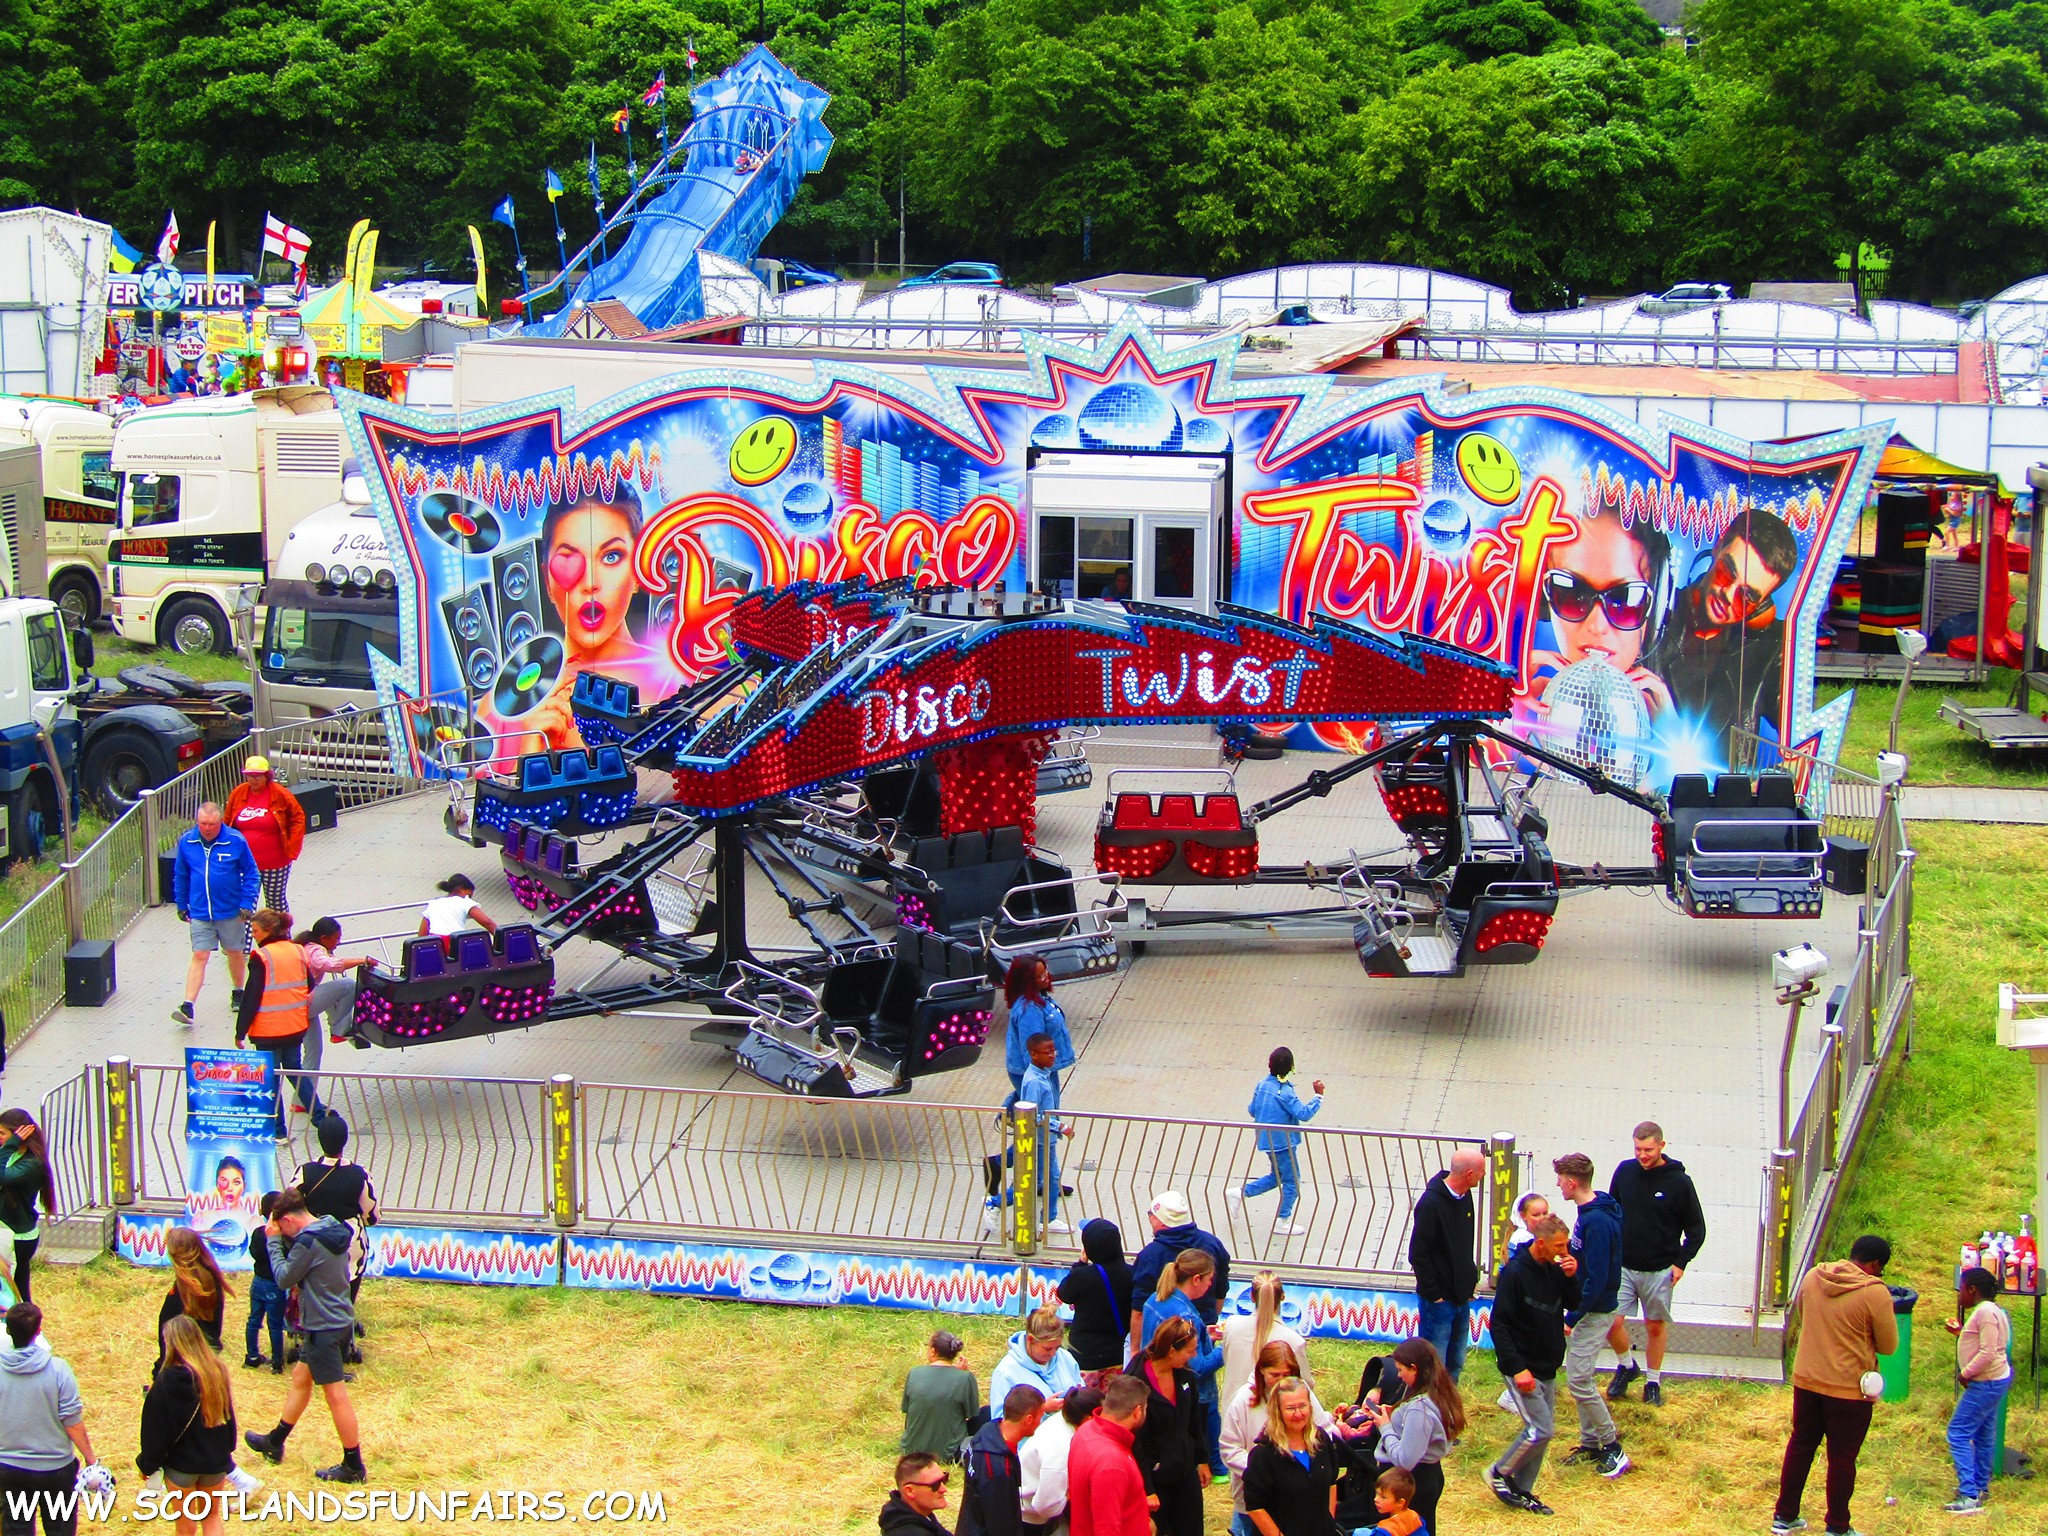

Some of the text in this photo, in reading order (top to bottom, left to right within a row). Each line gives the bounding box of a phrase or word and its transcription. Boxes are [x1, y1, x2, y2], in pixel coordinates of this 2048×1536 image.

[184, 283, 245, 306] PITCH
[127, 453, 222, 462] www.hornespleasurefairs.co.uk
[1243, 475, 1580, 698] Twist
[852, 648, 1321, 755] Disco Twist
[191, 1061, 268, 1084] Disco Twist
[108, 1072, 126, 1194] TWISTER
[552, 1091, 570, 1215] TWISTER
[1014, 1118, 1034, 1244] TWISTER
